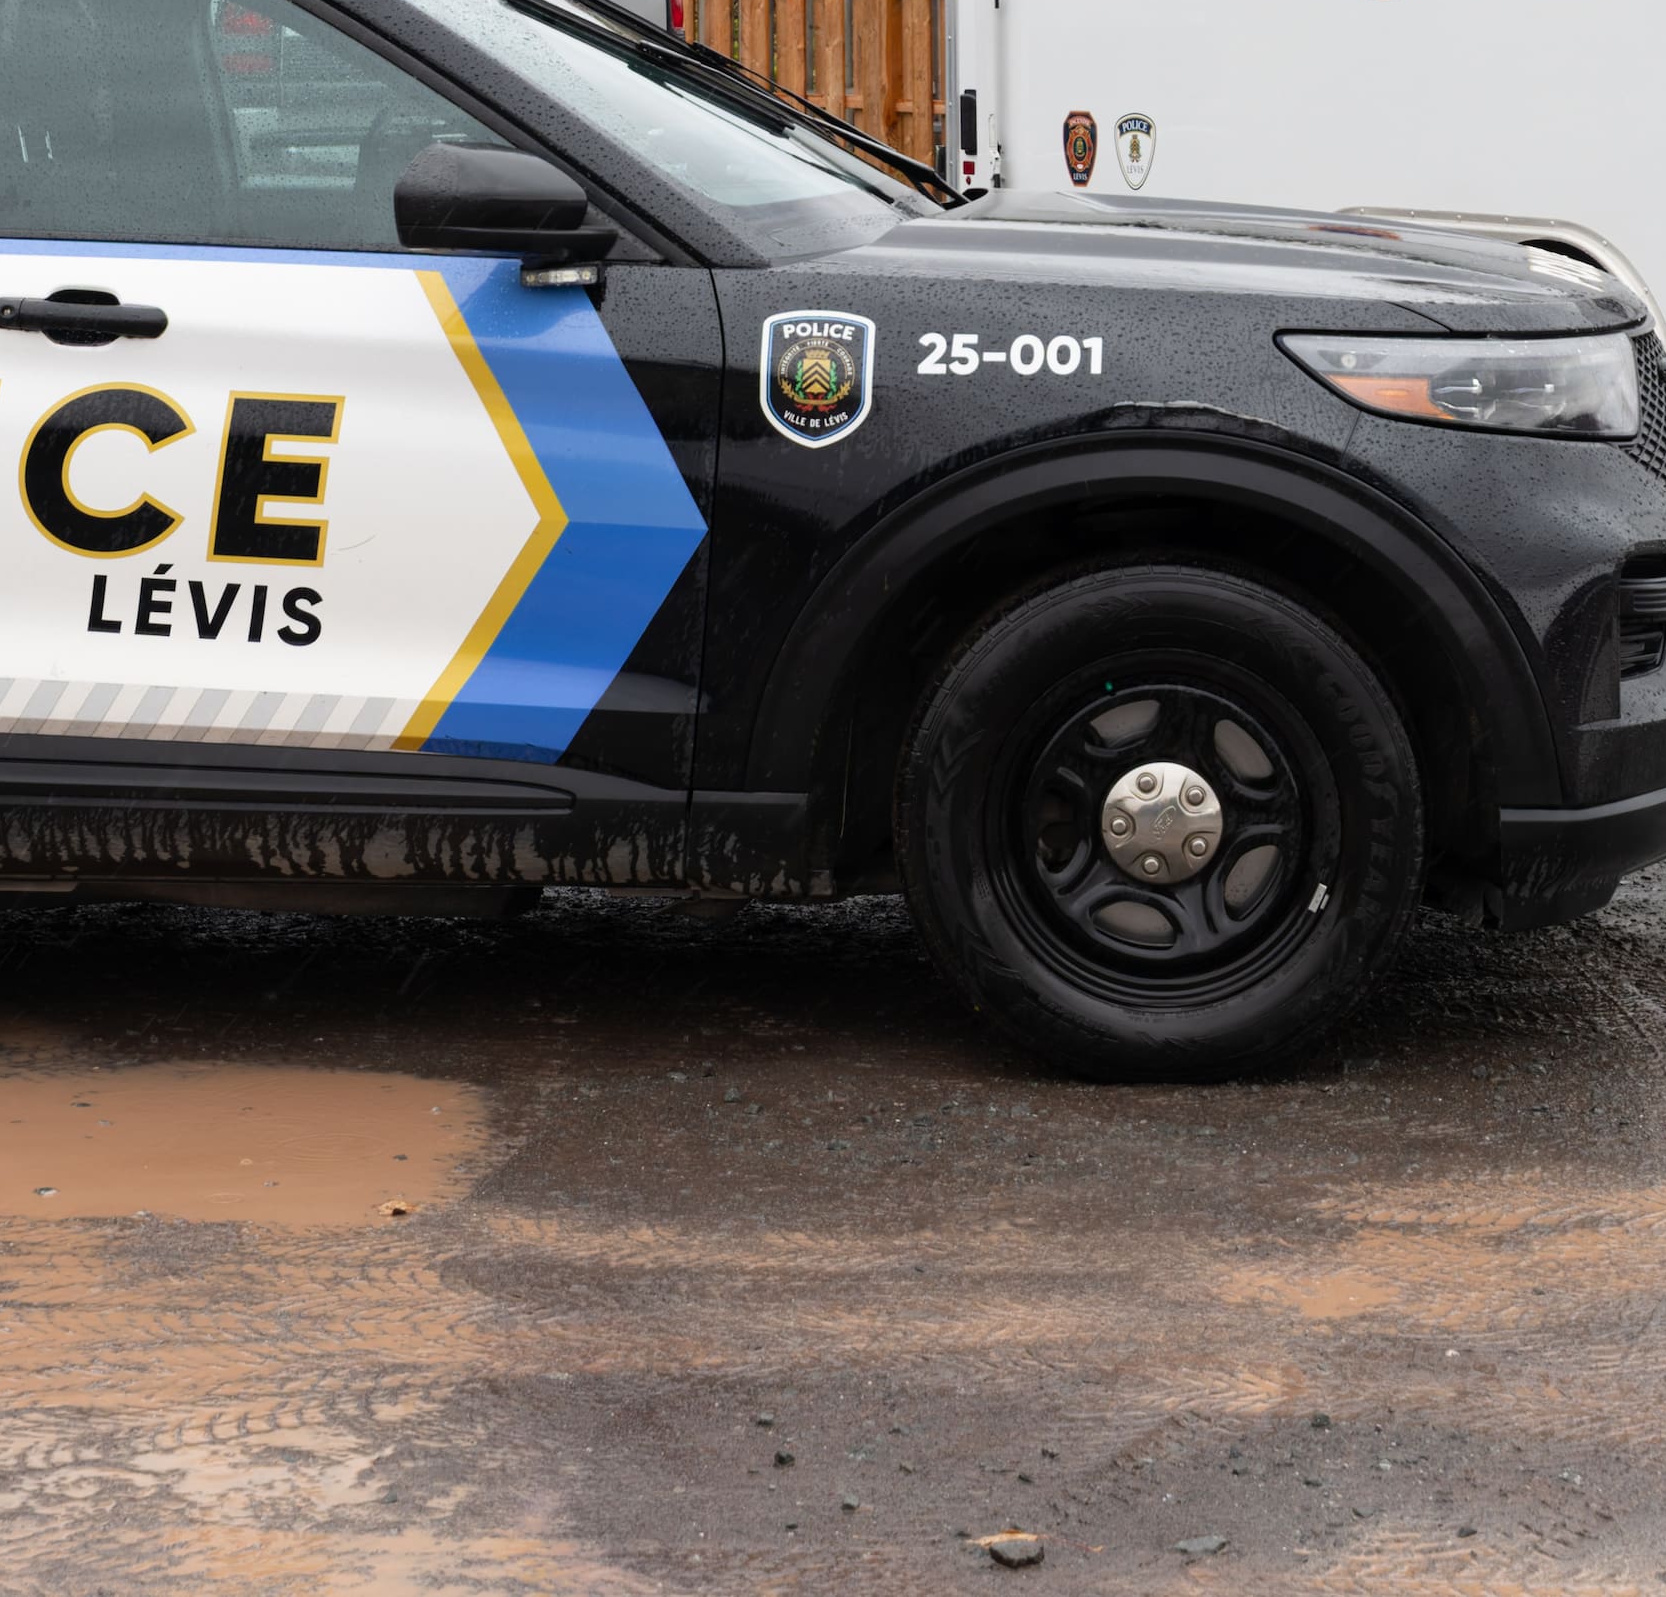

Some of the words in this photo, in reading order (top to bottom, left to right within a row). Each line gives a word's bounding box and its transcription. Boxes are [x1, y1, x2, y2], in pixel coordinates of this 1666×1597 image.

[1121, 119, 1149, 133] POLICE
[782, 322, 855, 341] POLICE
[917, 332, 1103, 376] 25-001
[783, 410, 807, 426] VILLE
[809, 418, 821, 428] DE
[824, 411, 849, 427] LÉVIS
[87, 564, 324, 646] LÉVIS
